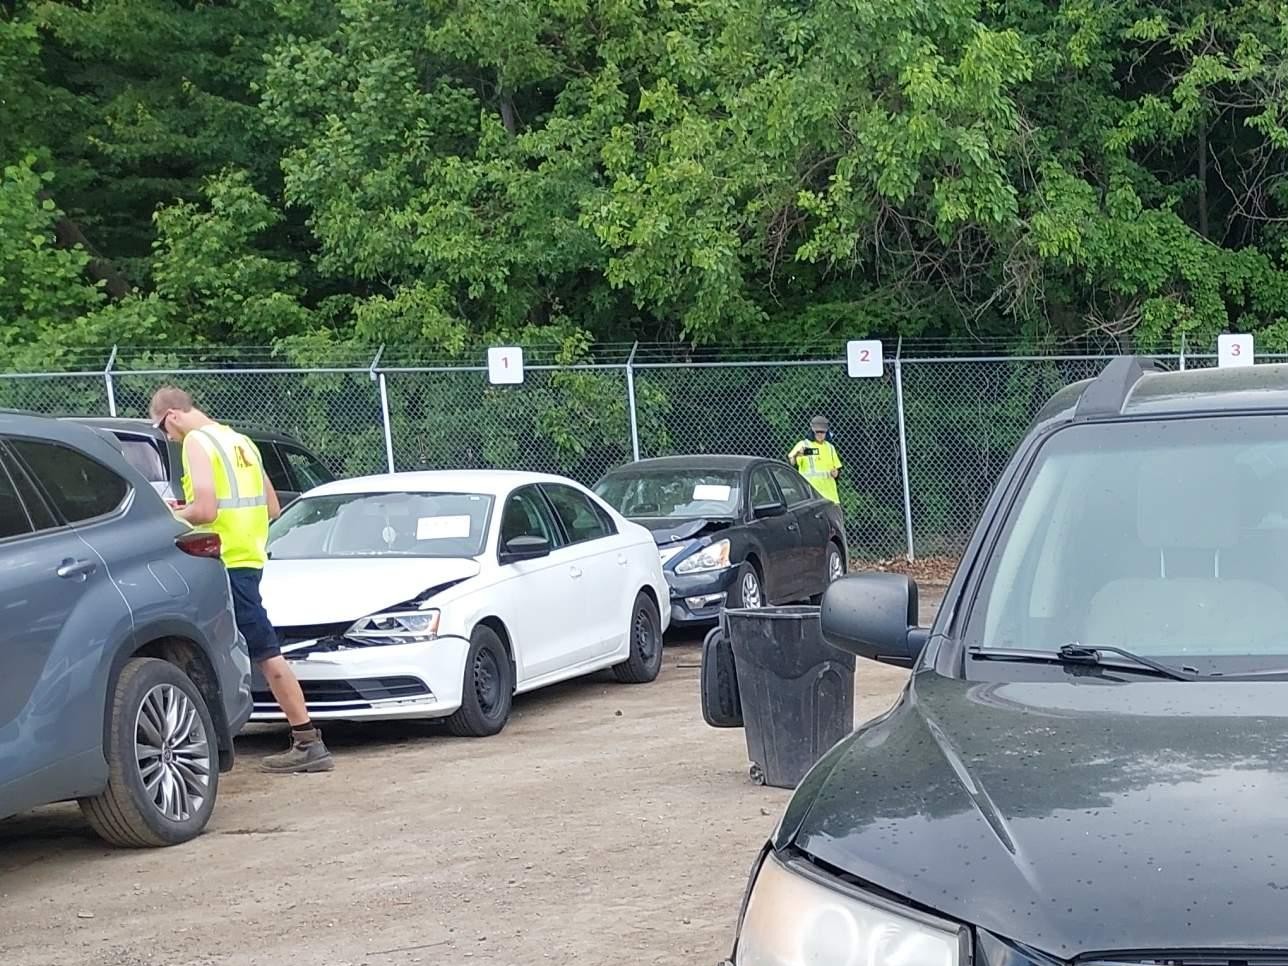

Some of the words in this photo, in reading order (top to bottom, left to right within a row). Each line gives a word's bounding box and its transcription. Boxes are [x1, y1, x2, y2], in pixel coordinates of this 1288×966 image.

[860, 349, 870, 362] 2
[1231, 343, 1241, 356] 3
[501, 356, 509, 368] 1
